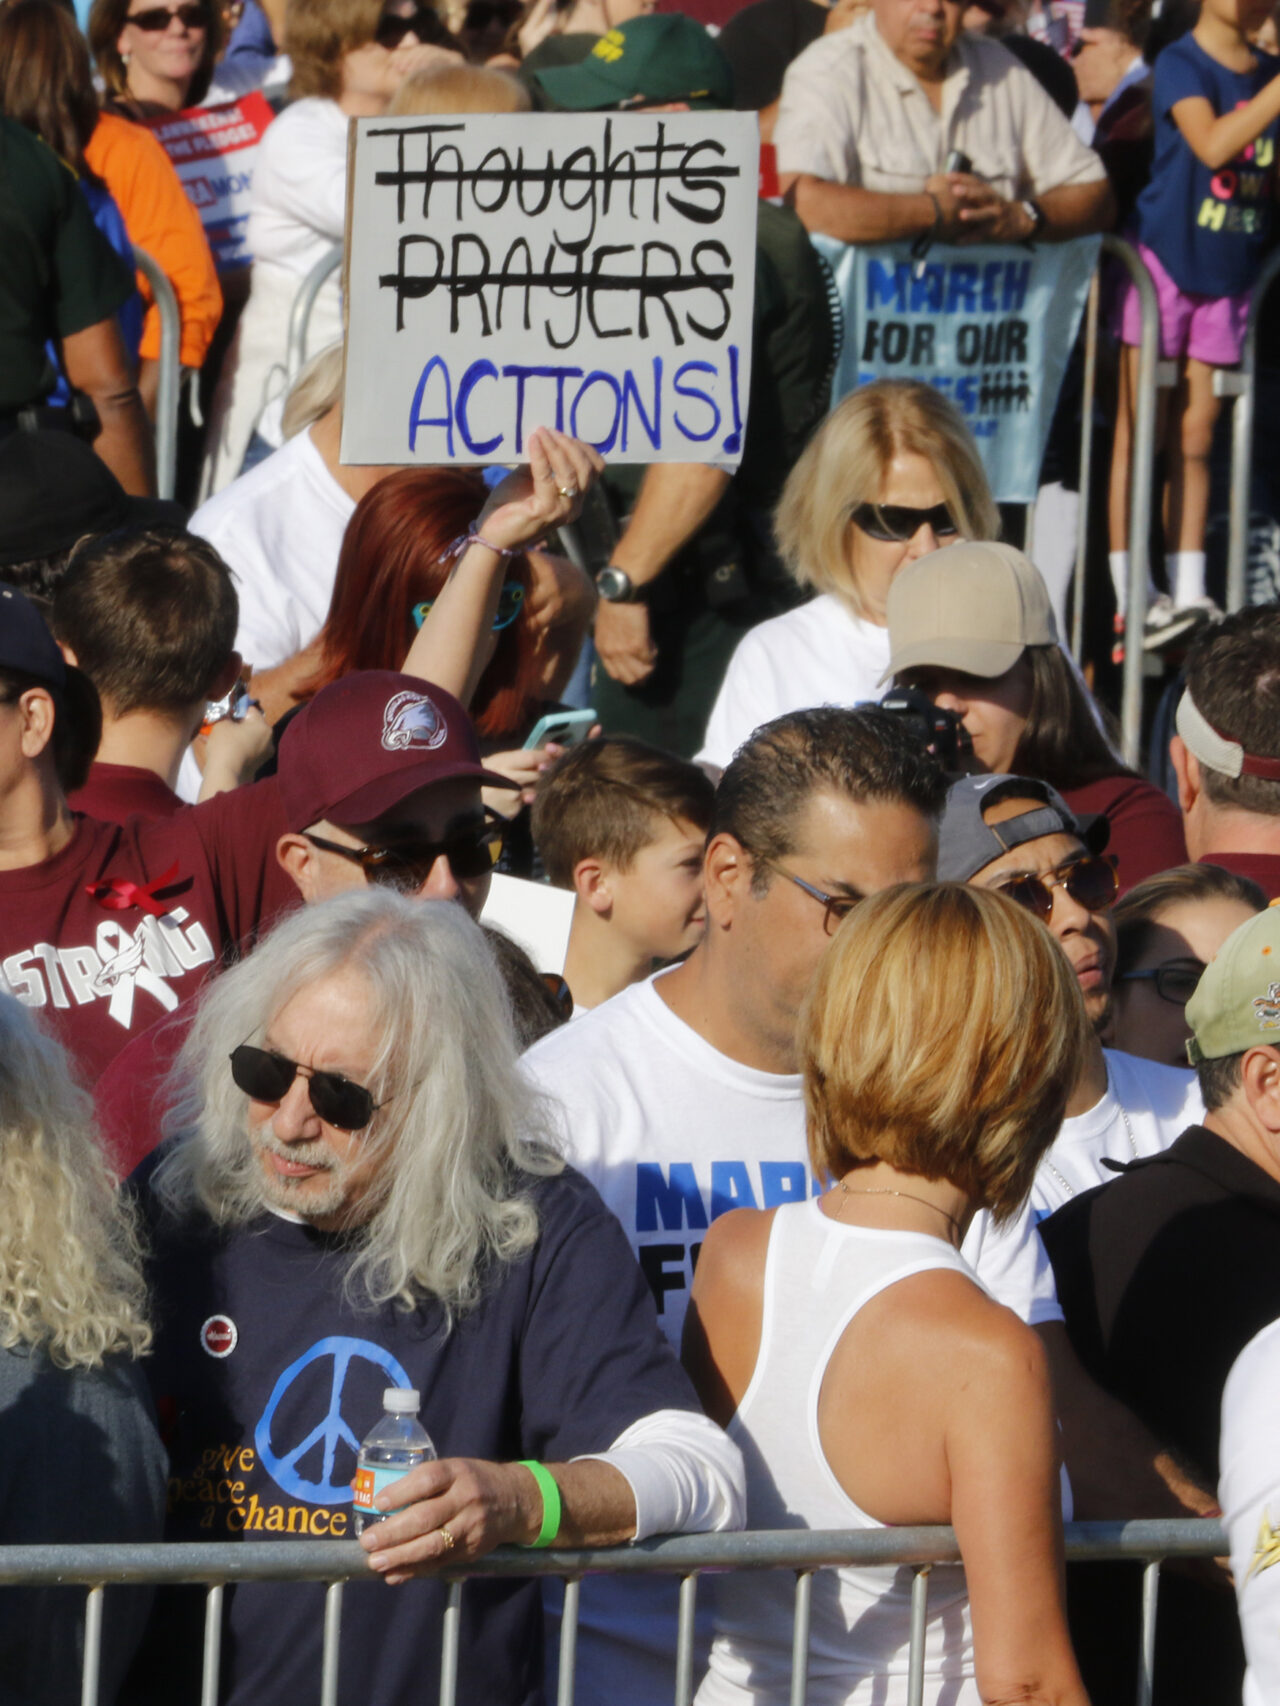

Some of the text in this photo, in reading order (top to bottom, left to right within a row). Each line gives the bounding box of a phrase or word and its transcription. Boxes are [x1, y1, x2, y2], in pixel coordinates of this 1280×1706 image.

[367, 118, 726, 254] Thoughts
[862, 318, 1028, 365] FOR OUR
[409, 345, 742, 457] ACTIONS!
[636, 1161, 824, 1232] MAR
[638, 1242, 702, 1315] F
[193, 1443, 255, 1480] give
[165, 1476, 245, 1513] peace
[200, 1494, 348, 1536] a chance
